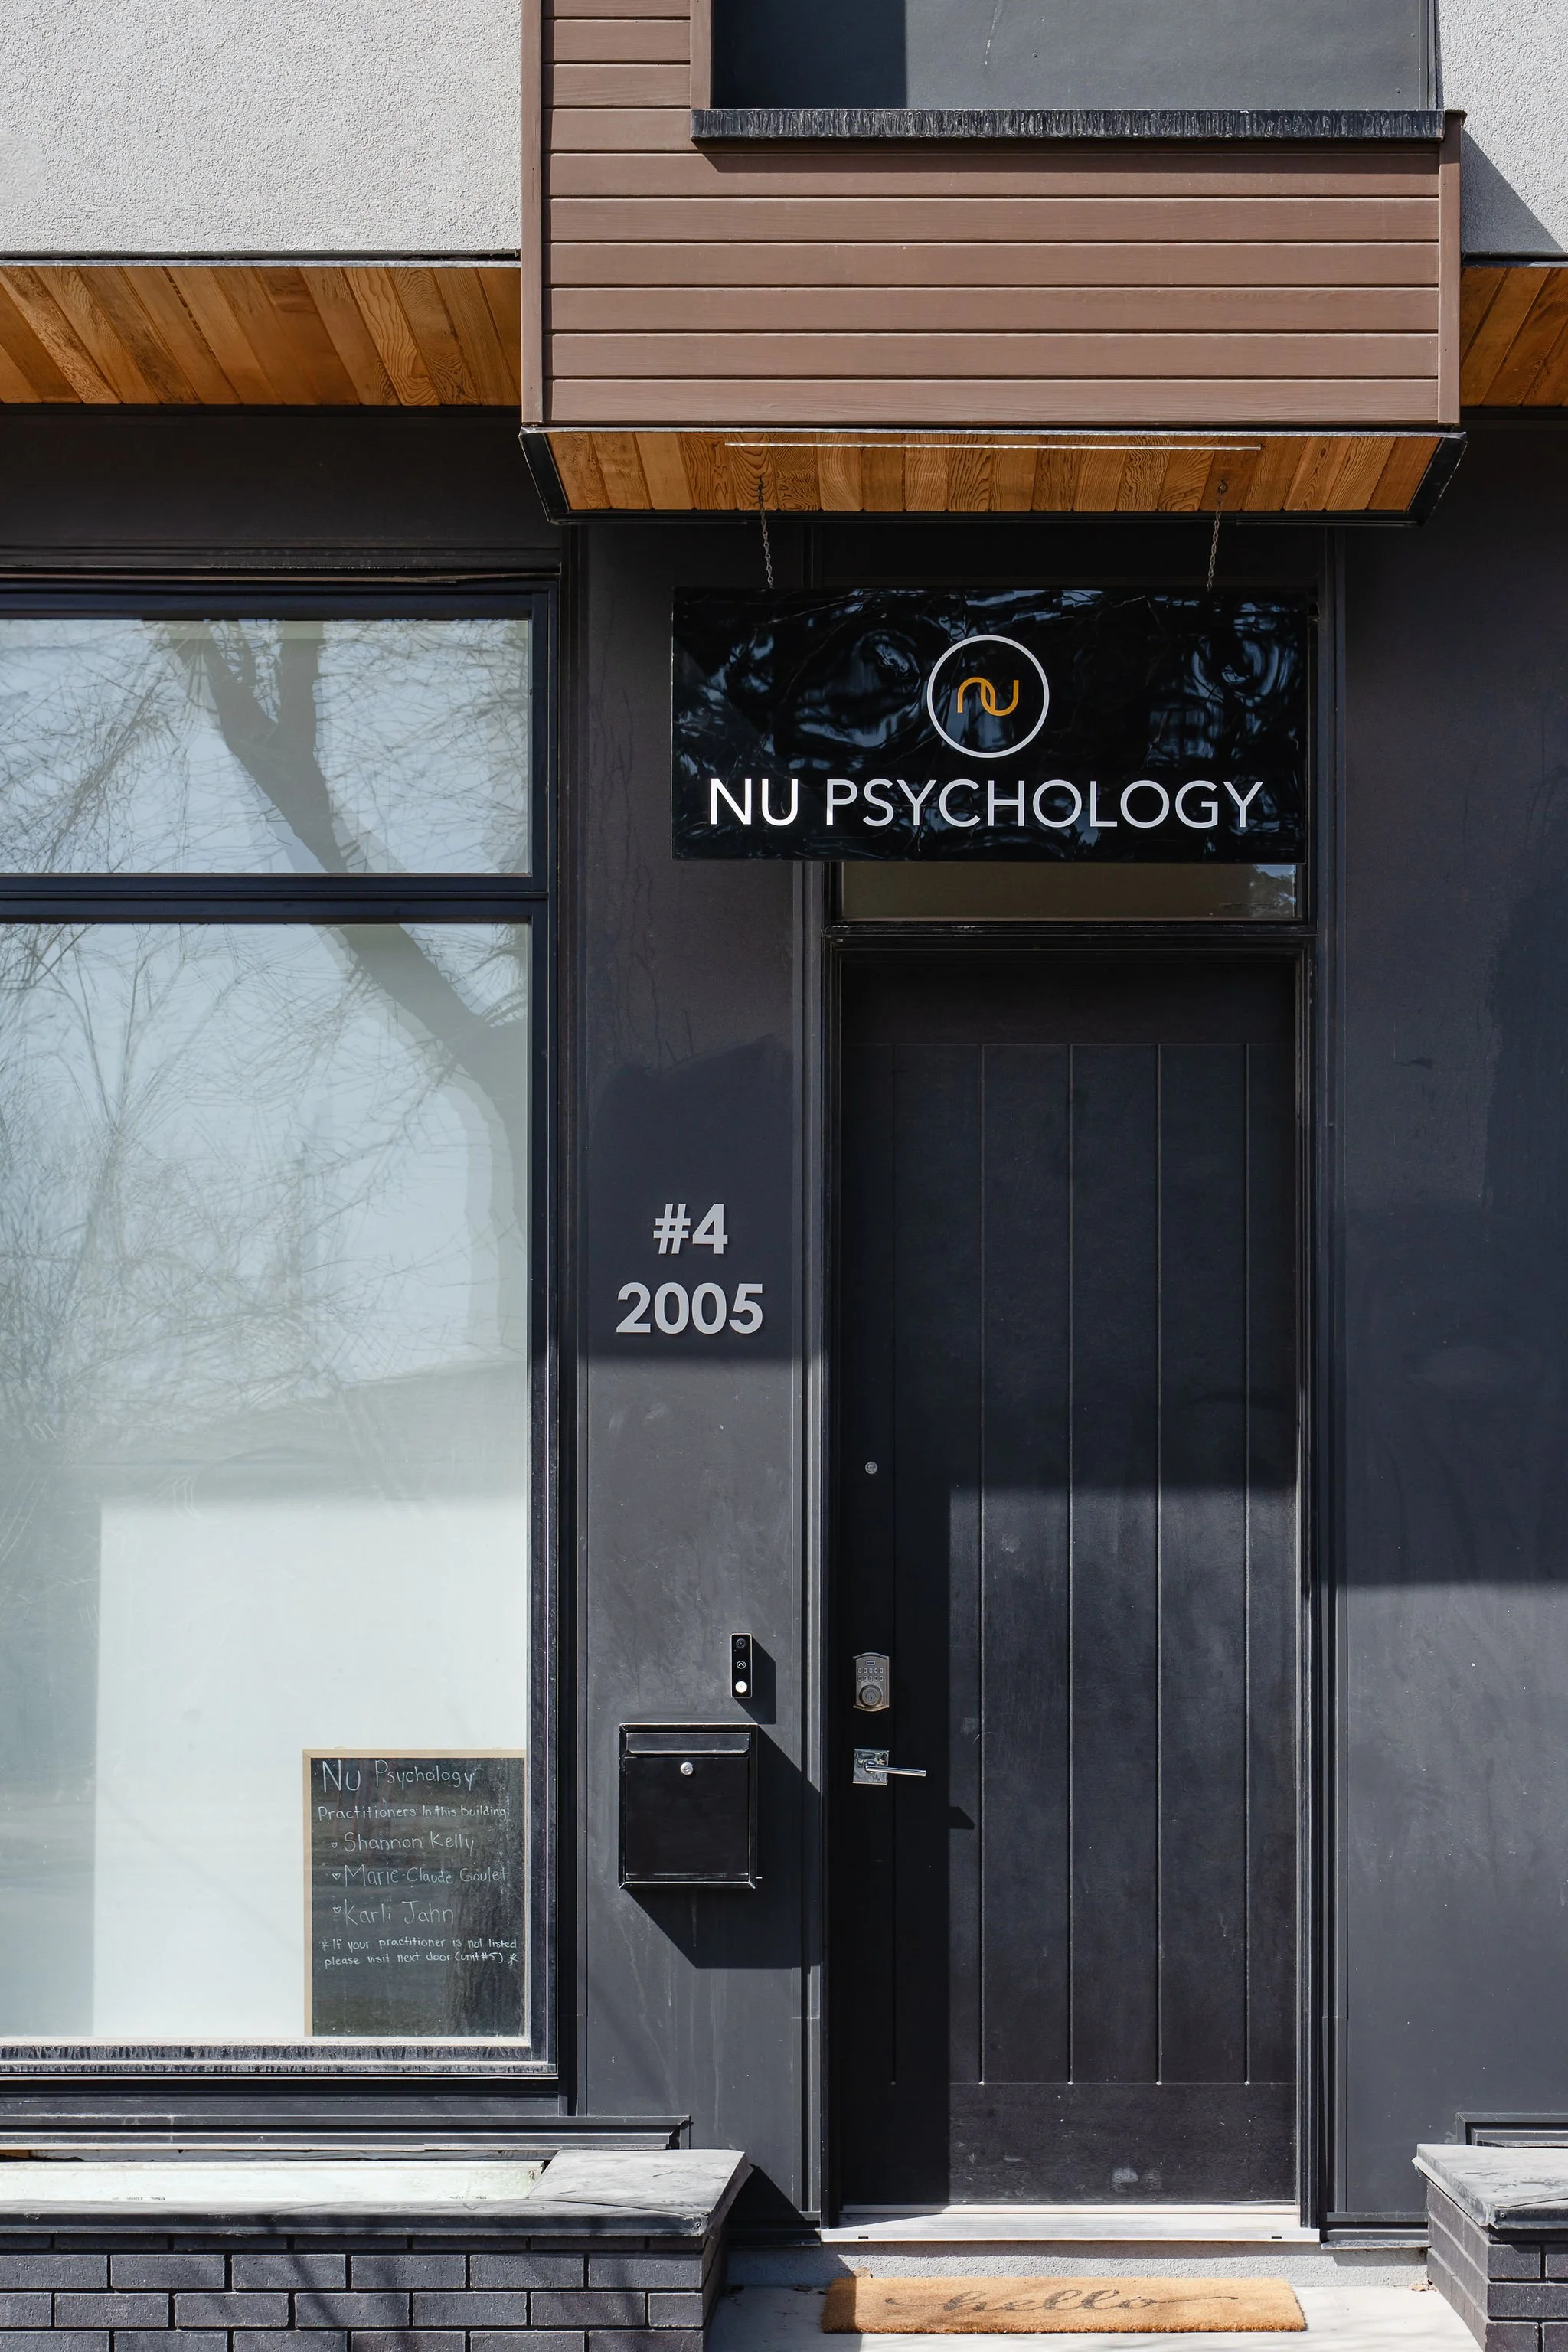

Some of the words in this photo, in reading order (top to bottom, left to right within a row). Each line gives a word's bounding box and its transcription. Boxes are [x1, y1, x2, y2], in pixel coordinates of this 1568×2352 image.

[709, 778, 799, 825] NU
[826, 779, 1263, 828] PSYCHOLOGY
[653, 1203, 728, 1255] #4
[616, 1282, 763, 1334] 2005
[374, 1759, 473, 1791] Psychology
[318, 1805, 416, 1821] Practitioners
[434, 1806, 457, 1818] this
[344, 1831, 422, 1852] Shannon
[430, 1831, 475, 1857] Kelly
[459, 1867, 510, 1883] Goulet
[344, 1898, 392, 1926] Karli
[401, 1900, 454, 1925] Jahn
[347, 1940, 371, 1953] your
[378, 1937, 446, 1949] practitioner
[452, 1937, 462, 1949] is
[467, 1938, 484, 1949] not
[488, 1938, 518, 1949] listed
[324, 1956, 361, 1970] please
[367, 1953, 391, 1965] visit
[397, 1952, 420, 1963] next
[426, 1951, 452, 1962] door
